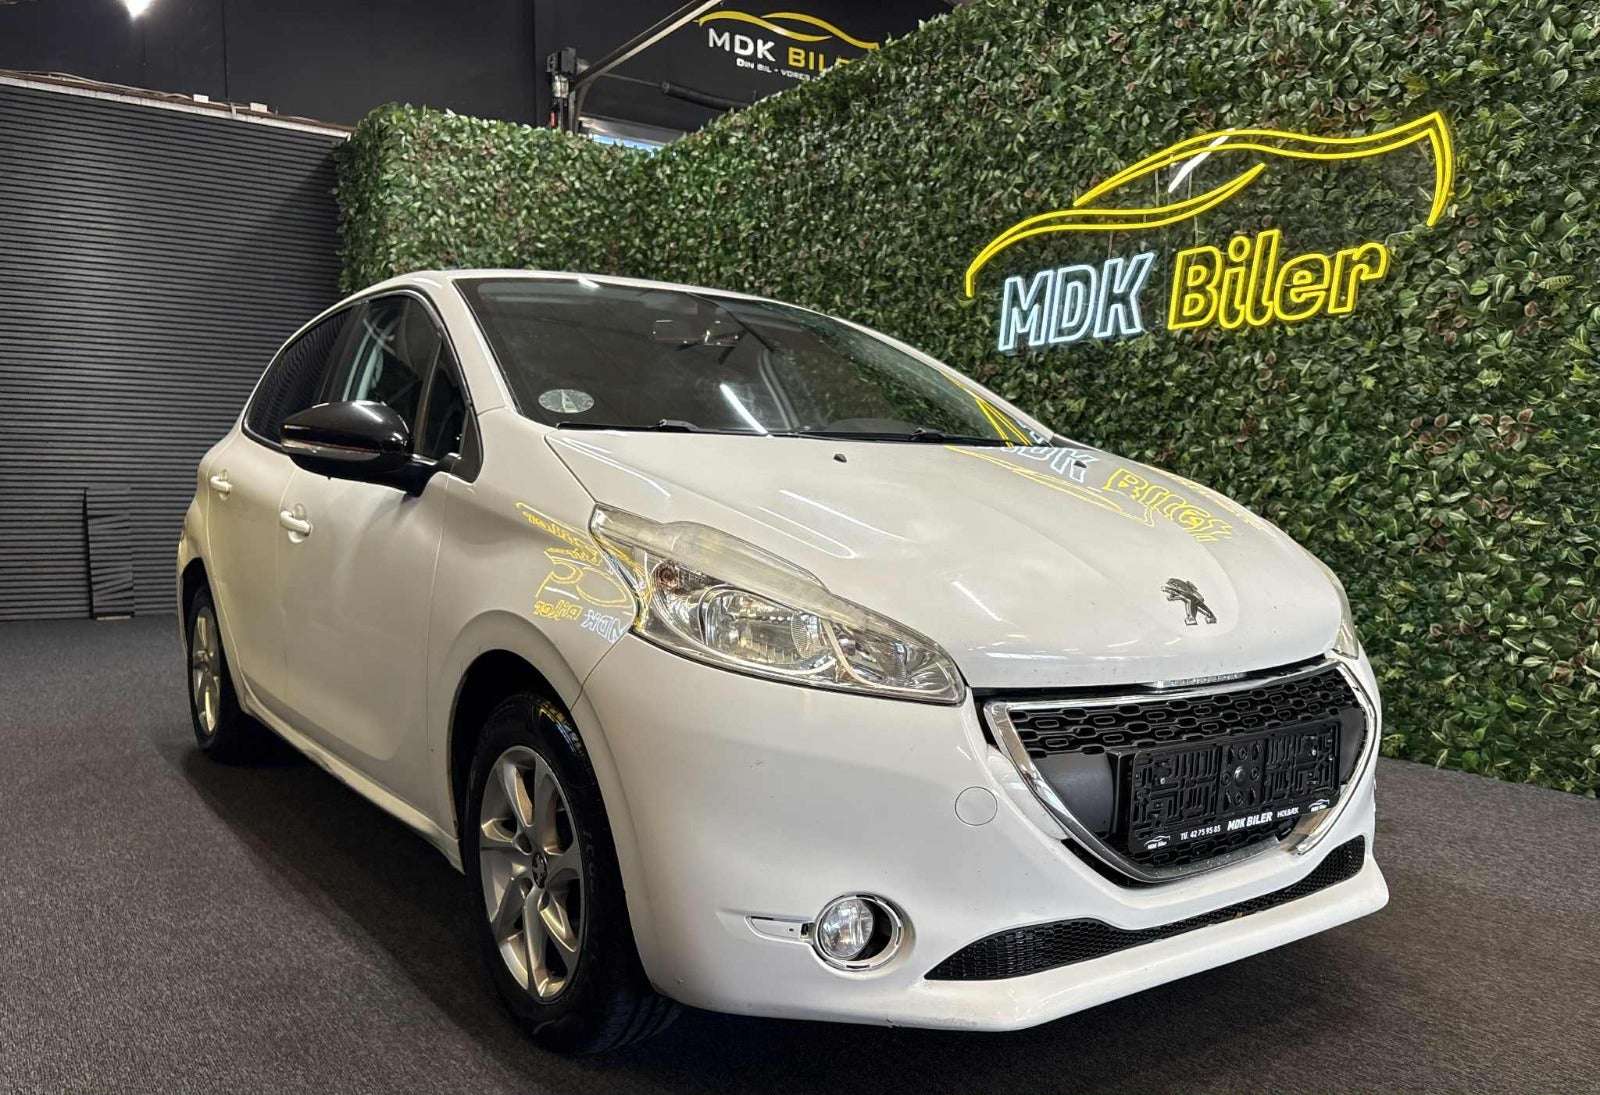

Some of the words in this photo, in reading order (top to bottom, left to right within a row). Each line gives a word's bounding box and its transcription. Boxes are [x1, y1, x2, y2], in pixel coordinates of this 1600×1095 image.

[708, 28, 776, 62] MDK
[998, 251, 1156, 351] MDK
[1167, 228, 1389, 331] Biler
[1246, 811, 1274, 828] BILER
